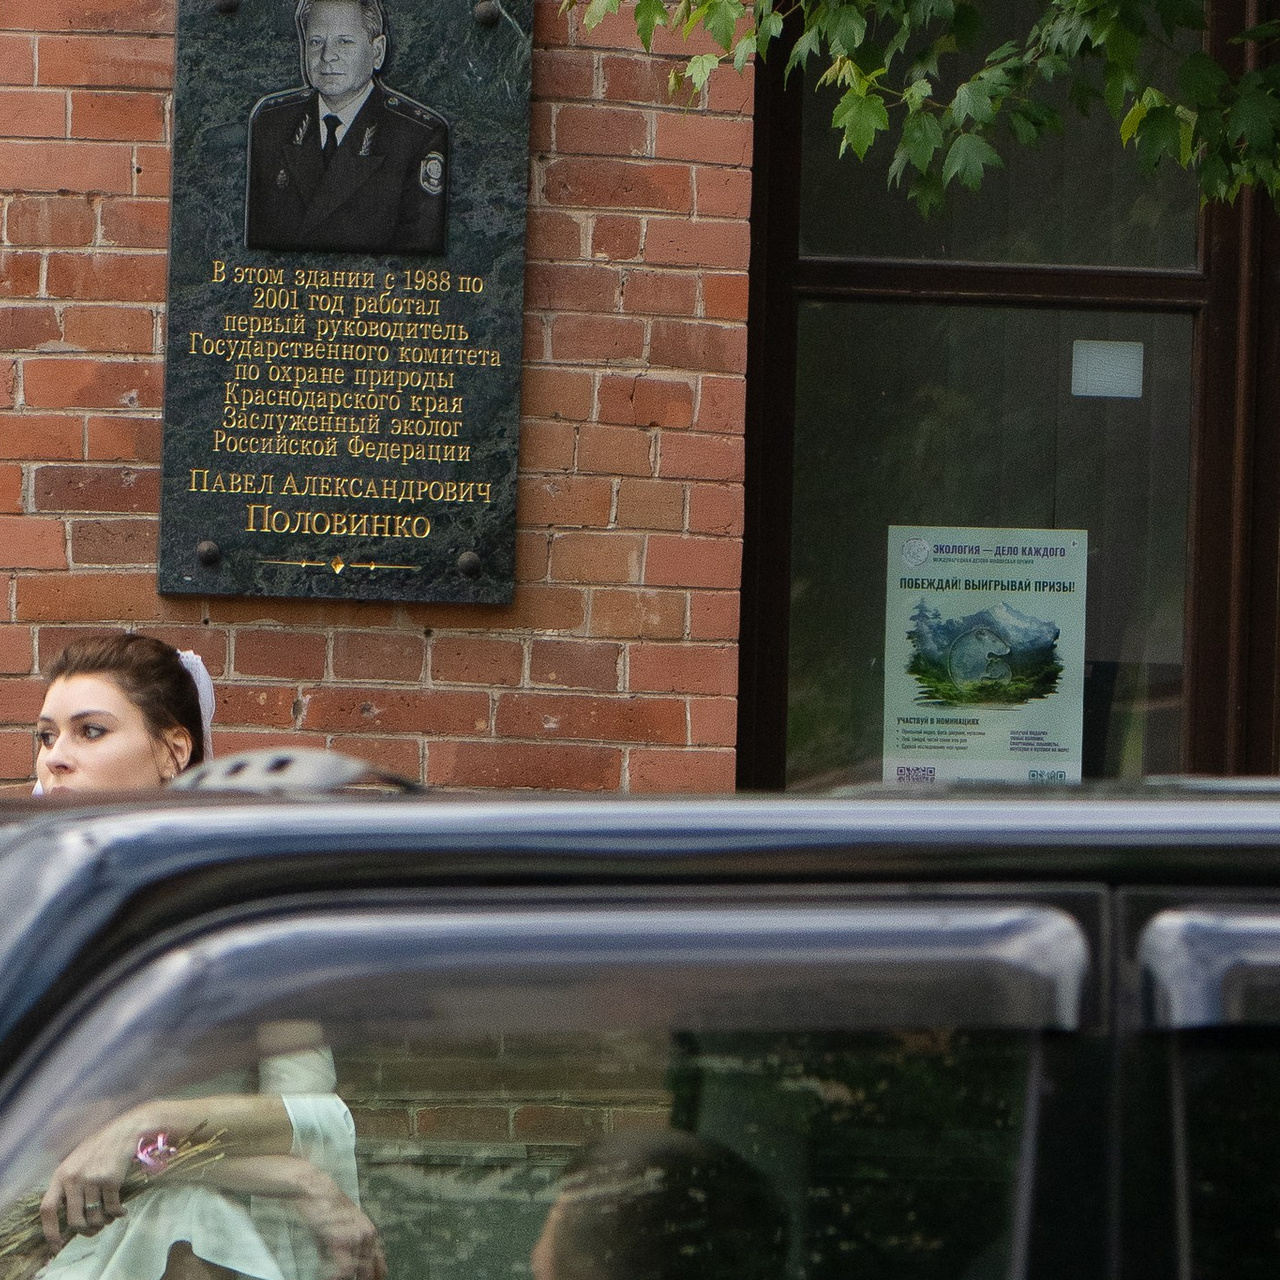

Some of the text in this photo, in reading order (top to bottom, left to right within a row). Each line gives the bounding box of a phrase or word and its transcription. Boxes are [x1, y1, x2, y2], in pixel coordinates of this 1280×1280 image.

[212, 260, 484, 294] В этом здании с 1988 по
[252, 287, 440, 318] 2001 год работал
[224, 314, 469, 342] первый руководитель
[188, 332, 501, 367] Государственного комитета
[234, 363, 455, 392] по охране природы
[224, 382, 464, 418] Краснодарского края
[222, 407, 463, 438] Заслуженный эколог
[212, 429, 471, 466] Российской Федерации
[933, 544, 980, 554] ЭКОЛОГИЯ
[994, 546, 1018, 557] ДЕЛО
[1021, 547, 1066, 558] КАЖДОГО
[900, 576, 1075, 592] ПОБЕЖДАЙ! ВЫИГРЫВАЙ ПРИЗЫ!
[897, 716, 928, 725] УЧАСТВУЙ
[936, 717, 979, 726] НОМИНАЦИЯХ
